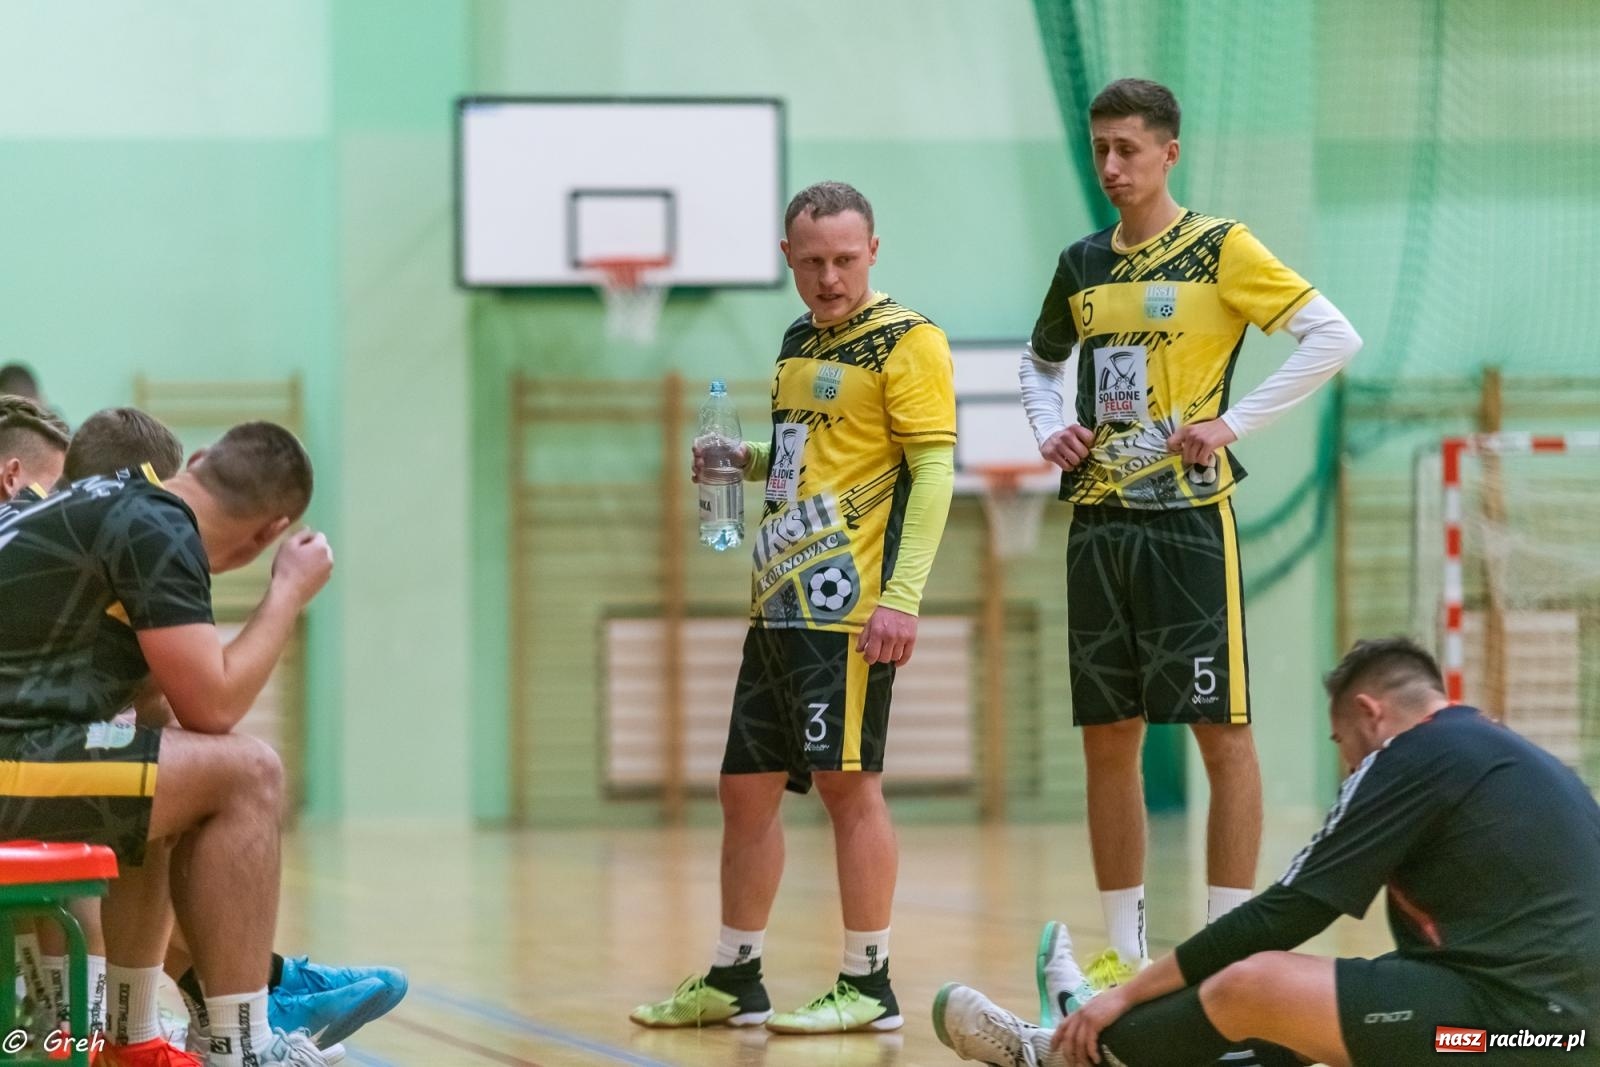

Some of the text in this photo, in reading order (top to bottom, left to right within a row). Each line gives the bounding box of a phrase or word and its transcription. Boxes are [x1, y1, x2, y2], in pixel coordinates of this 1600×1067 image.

[1082, 289, 1096, 327] 5
[1099, 391, 1140, 403] SOLIDNE
[1105, 401, 1133, 412] FELGI
[765, 506, 808, 561] KS
[760, 534, 841, 592] KORNOWAC
[1194, 656, 1216, 695] 5
[805, 703, 830, 742] 3
